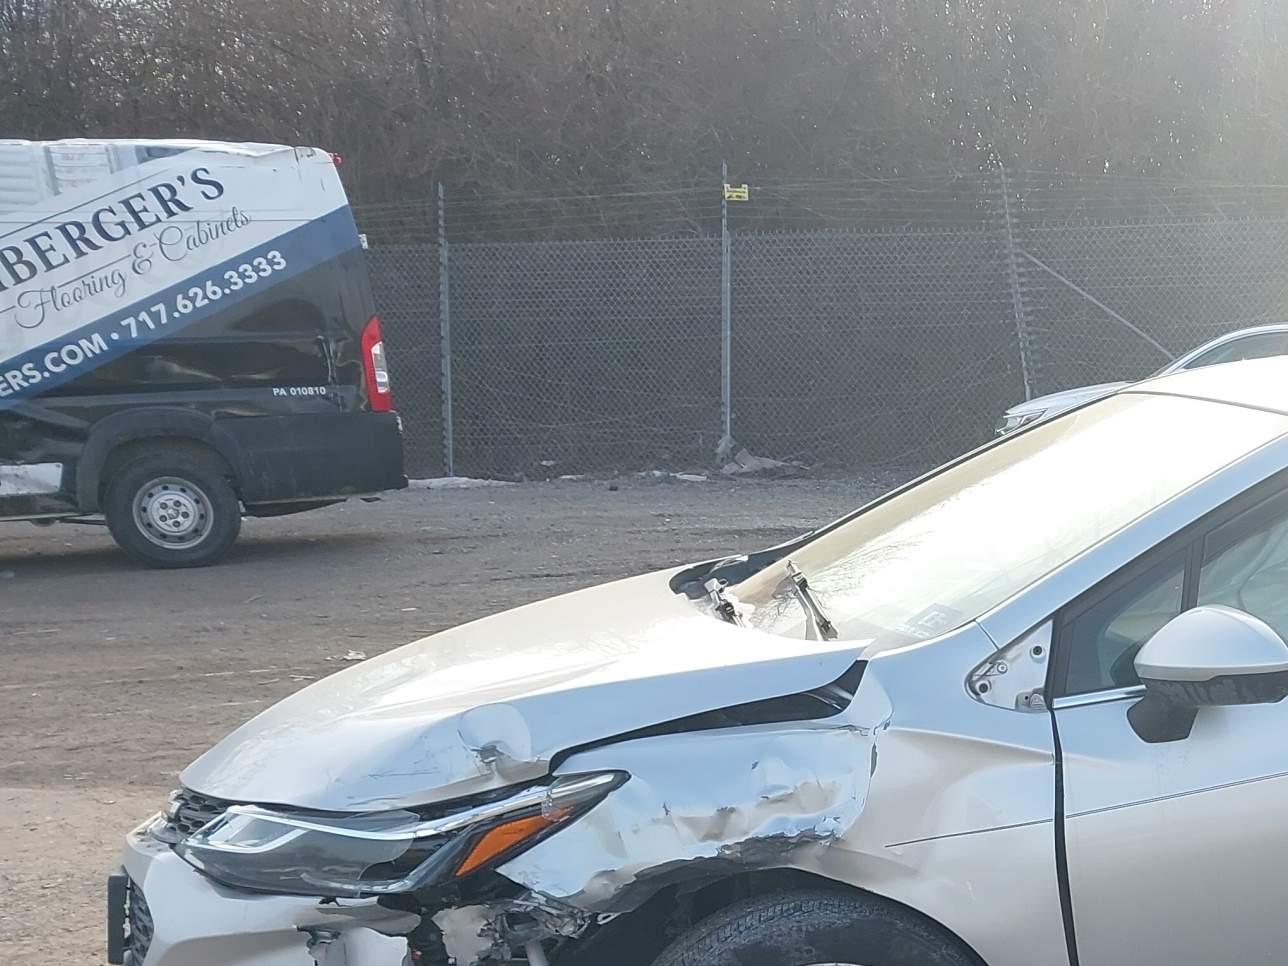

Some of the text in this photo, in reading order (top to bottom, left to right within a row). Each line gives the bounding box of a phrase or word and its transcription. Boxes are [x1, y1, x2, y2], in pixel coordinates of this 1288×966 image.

[0, 167, 224, 291] BERGER'S
[15, 206, 251, 329] Flooring & Cabinets
[120, 250, 287, 338] 717.626.3333
[272, 386, 326, 396] PA 010810
